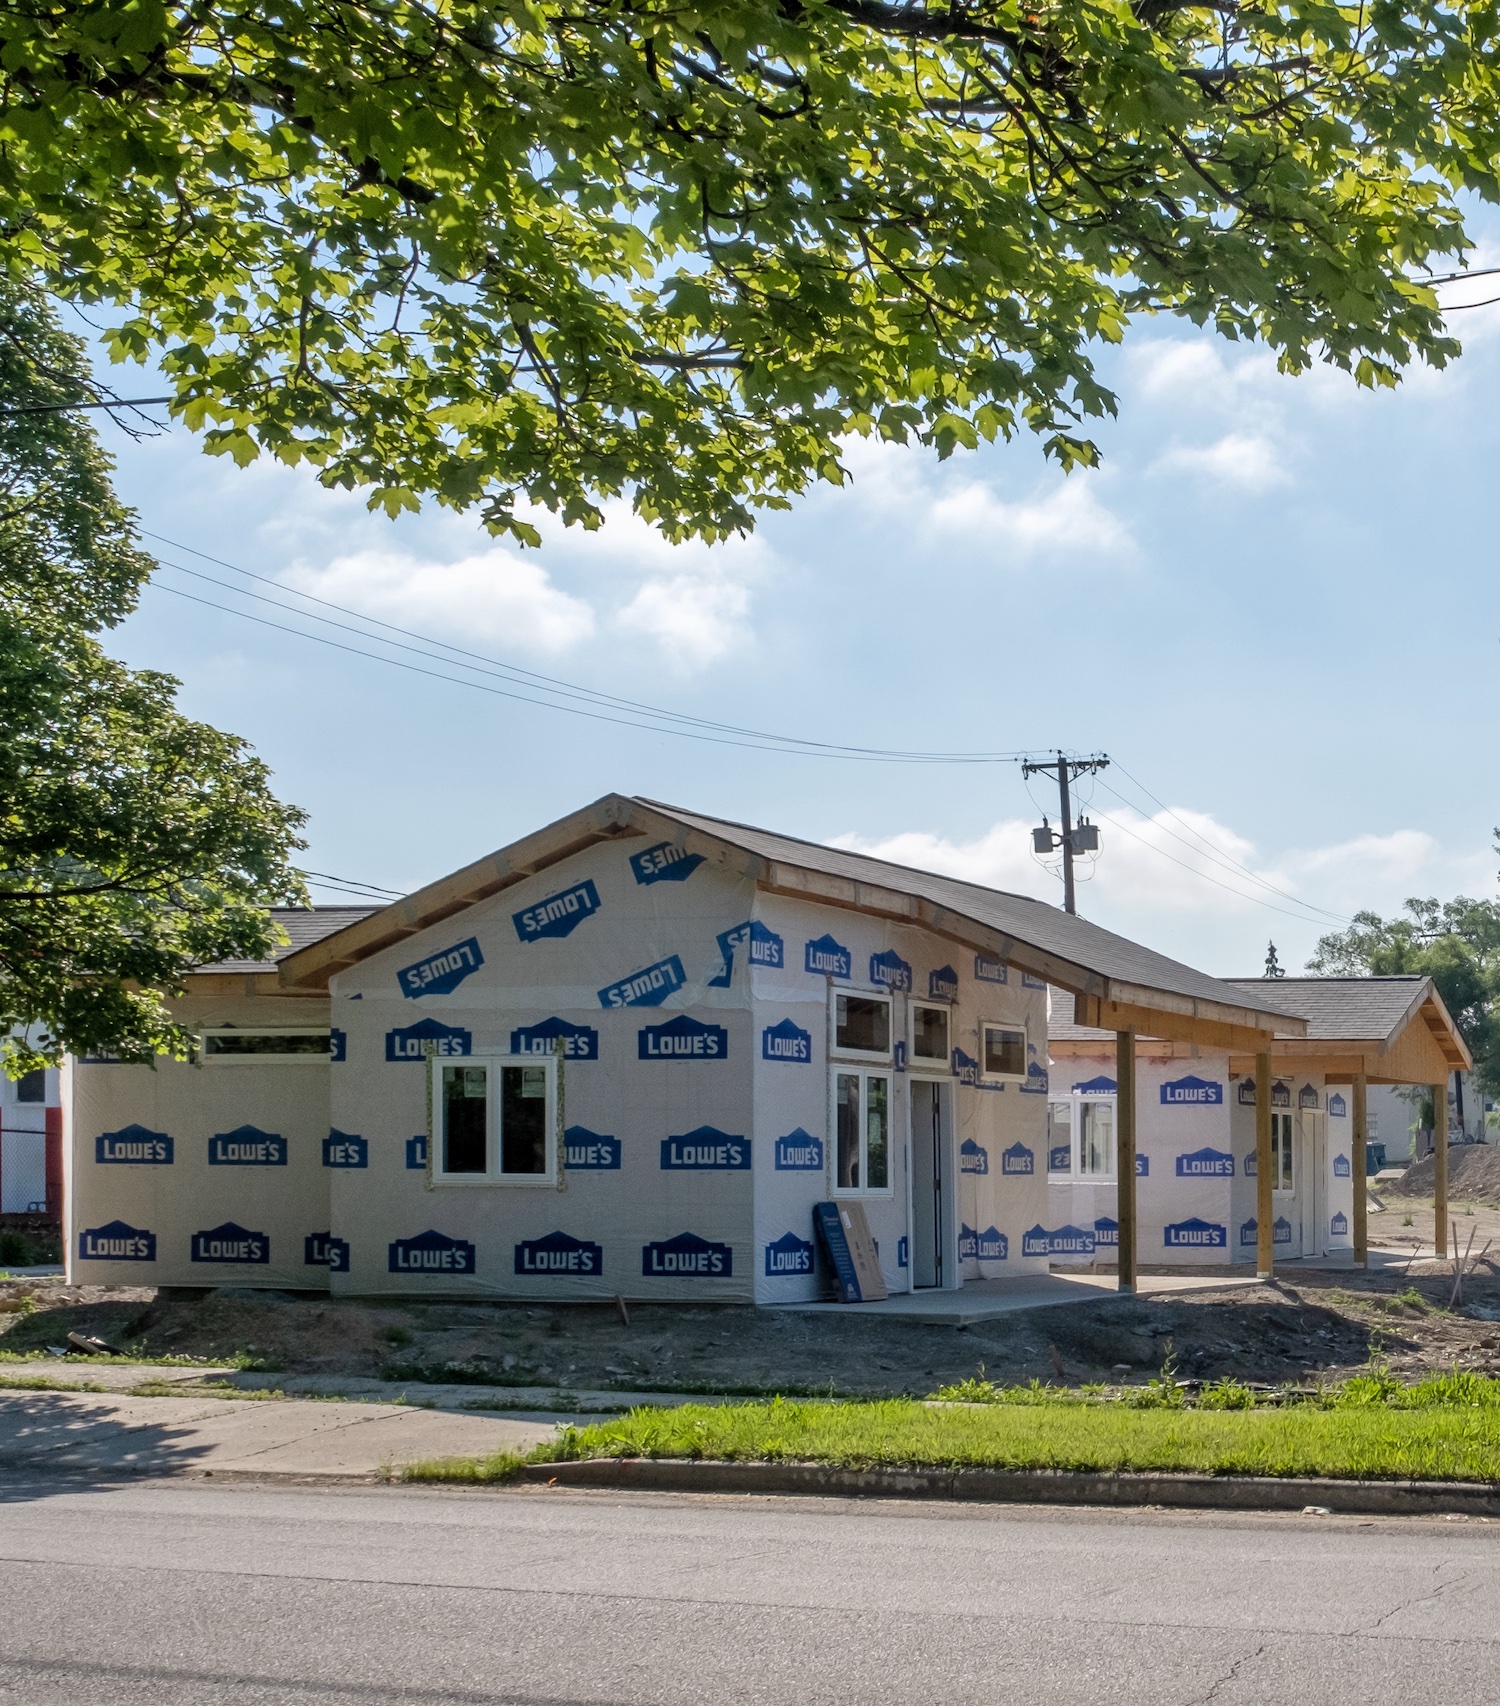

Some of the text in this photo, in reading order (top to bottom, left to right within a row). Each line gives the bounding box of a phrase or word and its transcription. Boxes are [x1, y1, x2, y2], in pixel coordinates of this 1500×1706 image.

[640, 846, 687, 874] WE'S
[523, 888, 592, 932] LOWE'S
[751, 940, 779, 963] WE'S
[809, 947, 847, 974] LOWE'S
[406, 945, 475, 989] LOWE'S
[873, 959, 908, 988] LOWE'S
[977, 958, 1005, 981] LOWE'S
[608, 963, 678, 1007] LOWE'S
[648, 1033, 718, 1055] LOWE'S
[767, 1034, 807, 1059] LOWE'S
[1166, 1086, 1216, 1101] LOWE'S
[104, 1139, 166, 1160] LOWE'S
[216, 1140, 279, 1161] LOWE'S
[670, 1143, 742, 1165] LOWE'S
[780, 1145, 818, 1166] LOWE'S
[1005, 1154, 1031, 1171] LOWE'S
[1182, 1158, 1232, 1174] LOWE'S
[86, 1235, 148, 1257] LOWE'S
[1025, 1236, 1049, 1253] LOWE'S
[1170, 1228, 1220, 1244] LOWE'S
[200, 1236, 261, 1259] LOWE'S
[398, 1247, 466, 1269] LOWE'S
[978, 1239, 1005, 1256] LOWE'S
[523, 1248, 593, 1271] LOWE'S
[652, 1249, 723, 1272] LOWE'S
[770, 1248, 810, 1270] LOWE'S
